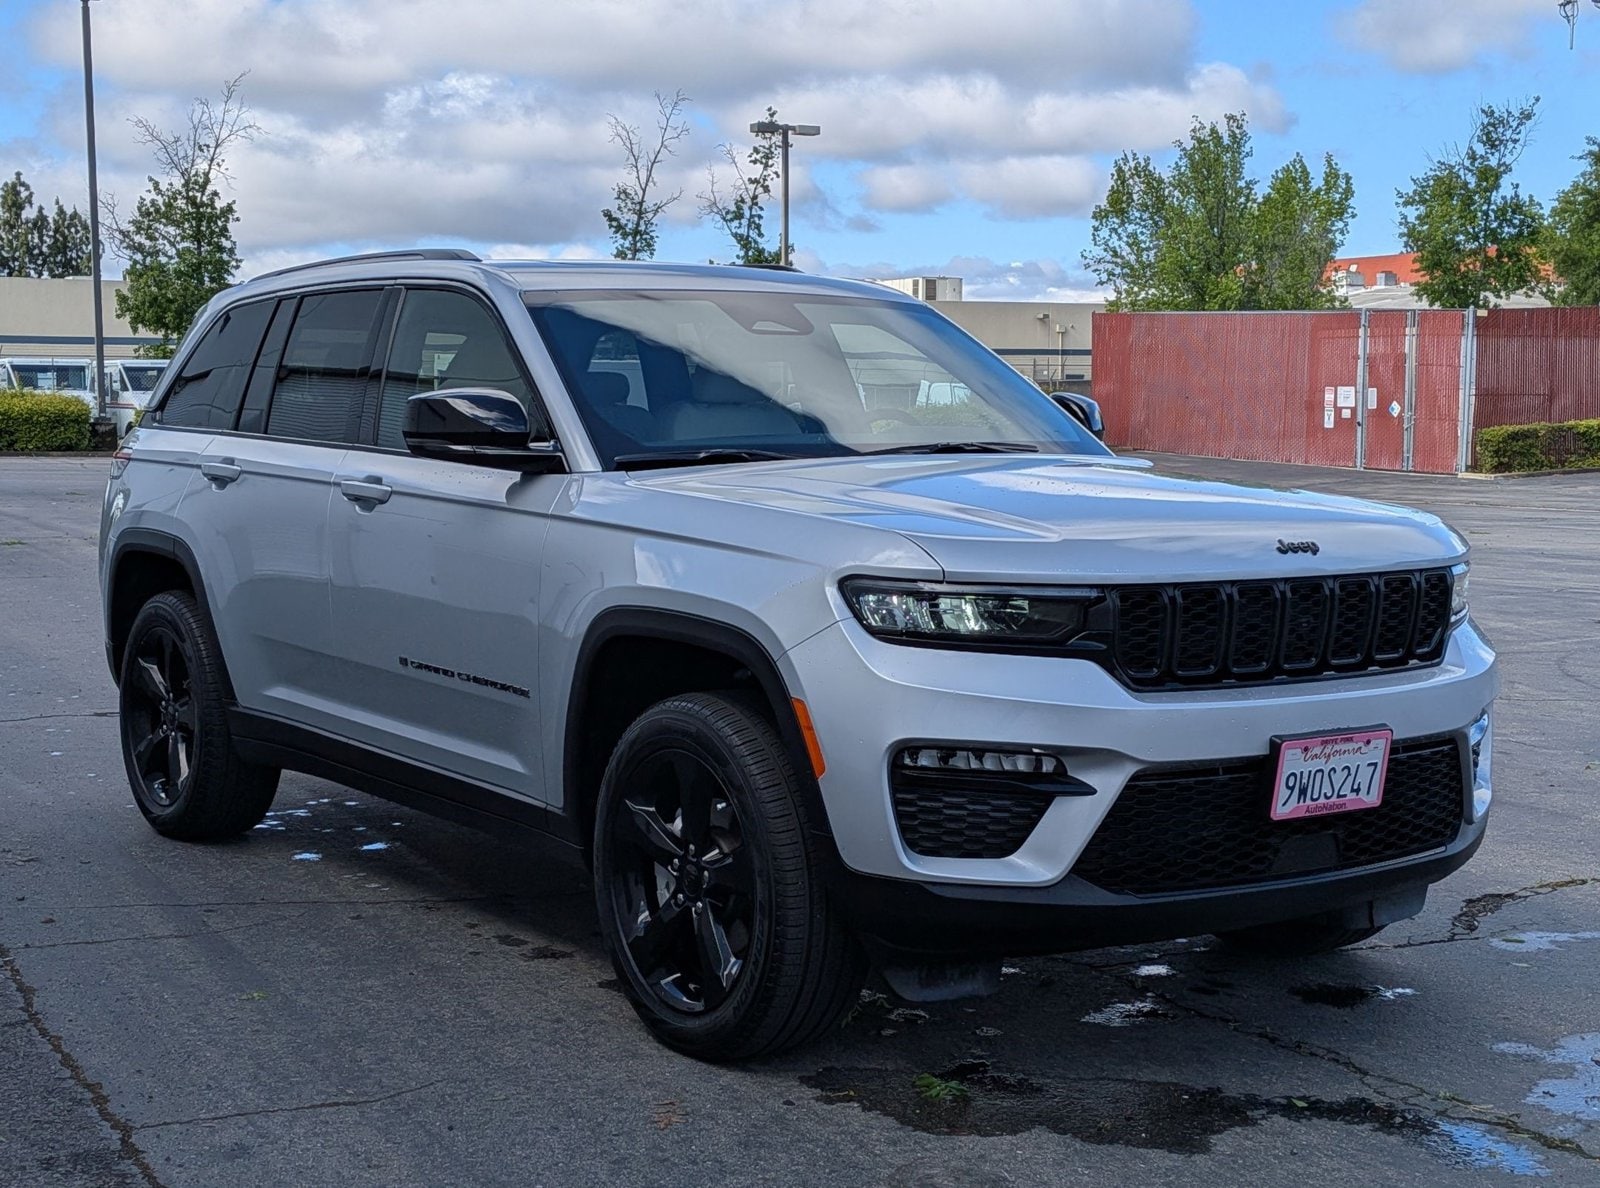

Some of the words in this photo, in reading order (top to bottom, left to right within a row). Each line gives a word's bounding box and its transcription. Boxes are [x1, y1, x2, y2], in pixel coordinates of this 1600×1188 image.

[1276, 539, 1320, 556] Jeep
[410, 660, 455, 679] GRAND
[457, 672, 531, 699] CHEROKEE
[1302, 744, 1368, 764] California
[1304, 802, 1347, 814] AutoNation
